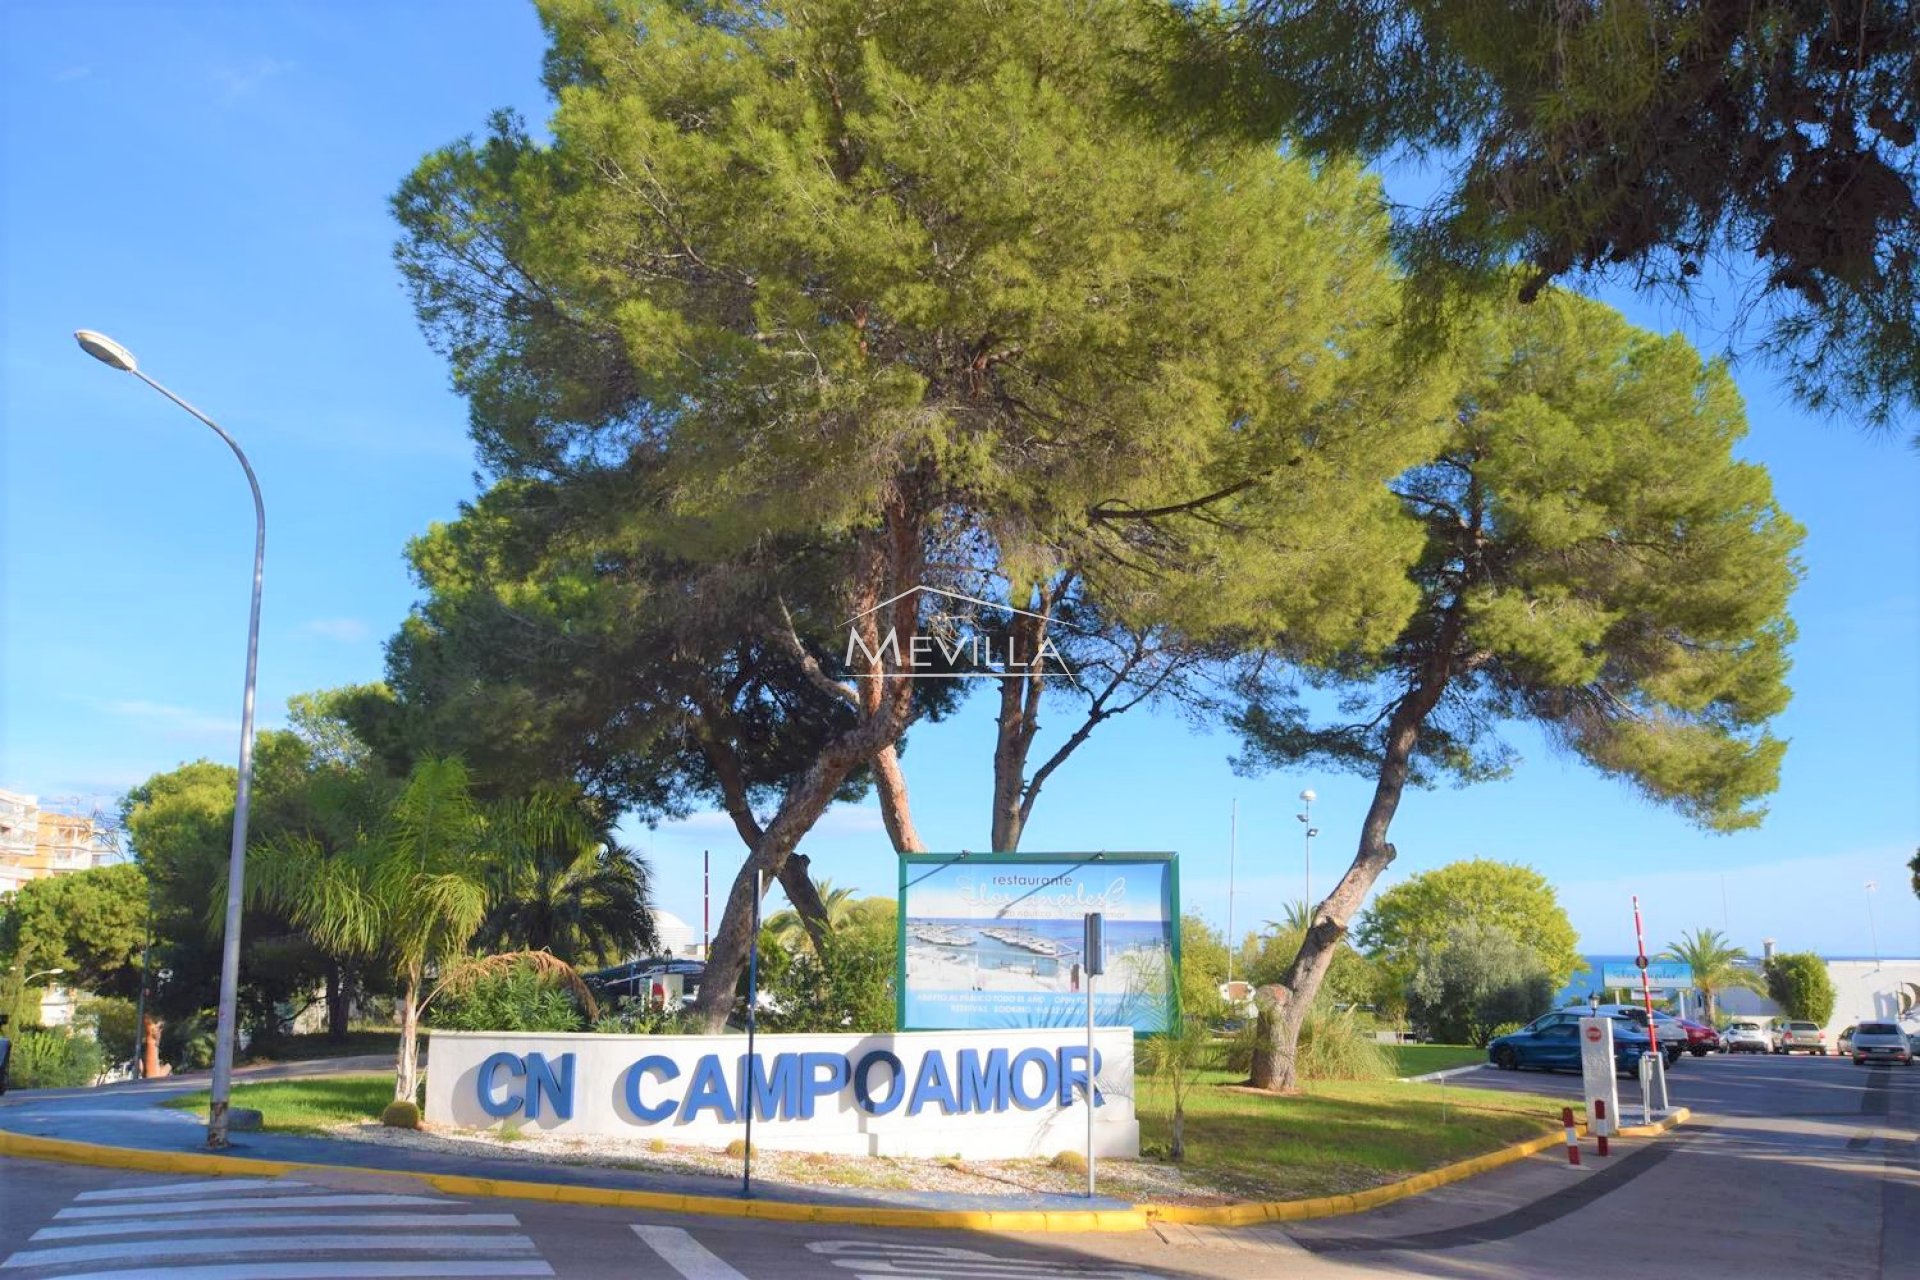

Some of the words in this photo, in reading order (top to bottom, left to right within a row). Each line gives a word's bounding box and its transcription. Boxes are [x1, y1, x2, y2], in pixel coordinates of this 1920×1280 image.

[992, 875, 1073, 886] restaurante
[477, 1052, 577, 1119] CN
[625, 1045, 1105, 1122] CAMPOAMOR
